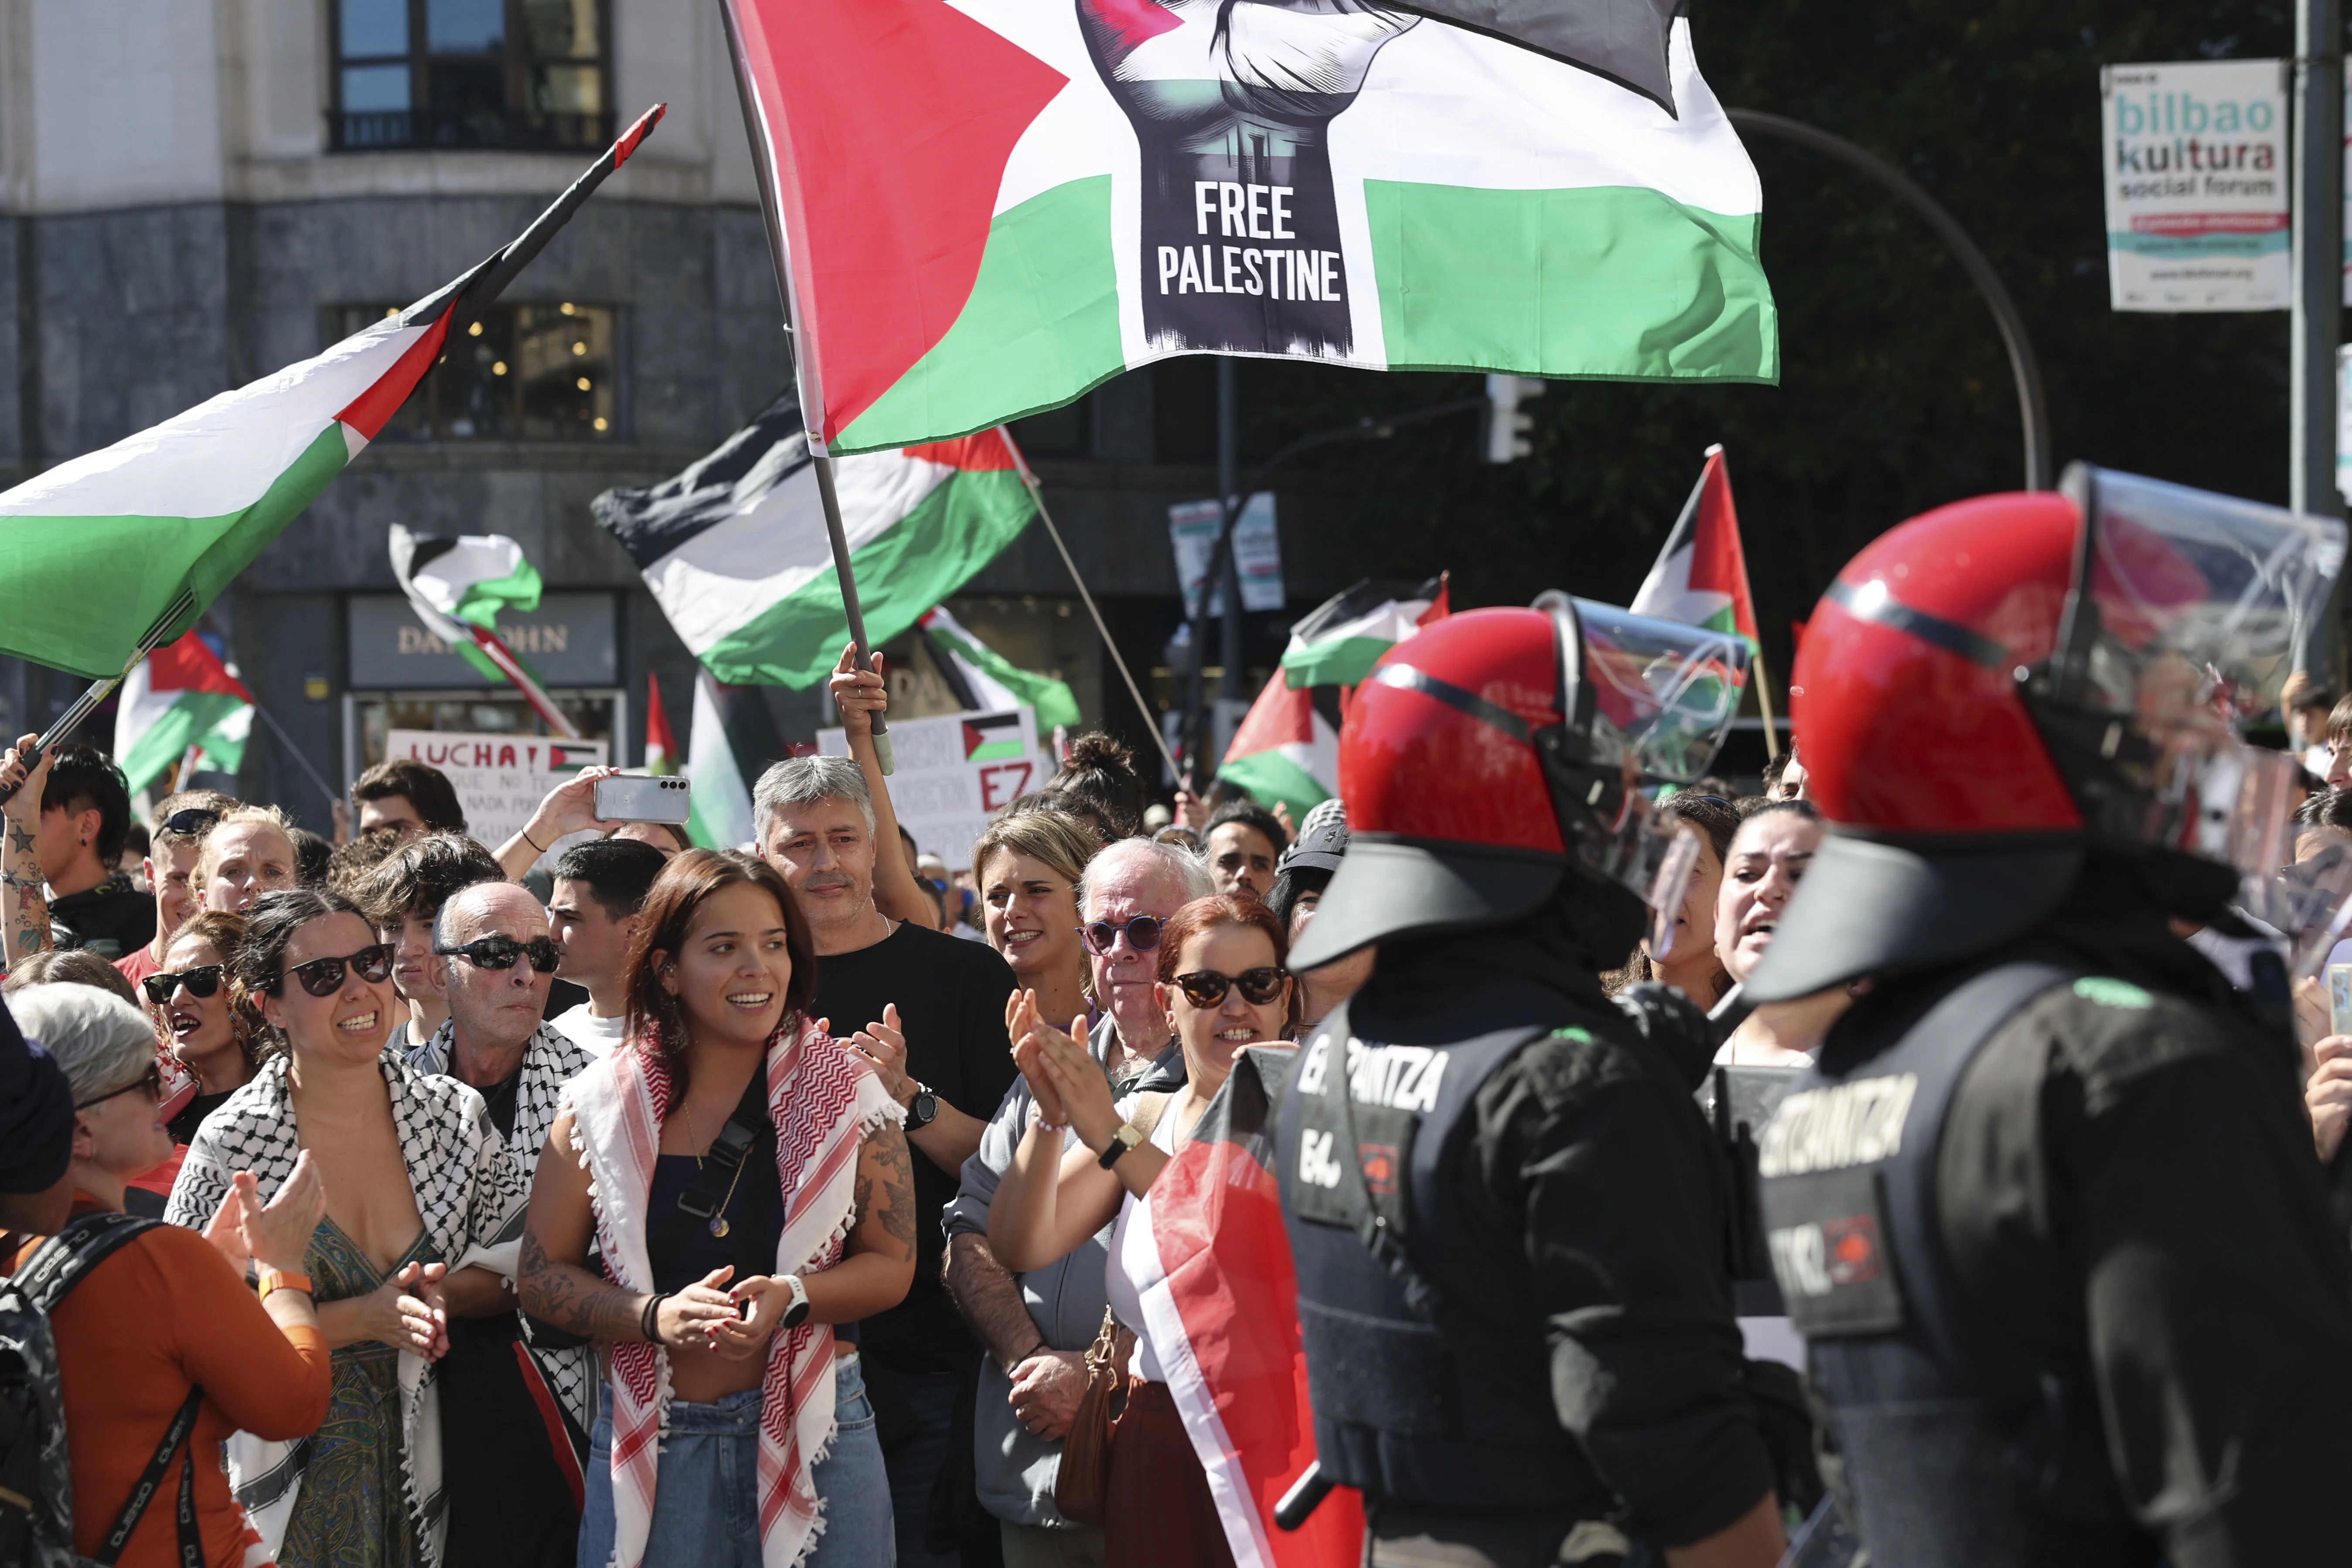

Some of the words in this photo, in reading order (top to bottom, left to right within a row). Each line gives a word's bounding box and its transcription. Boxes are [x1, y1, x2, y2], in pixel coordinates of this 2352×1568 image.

[2116, 91, 2274, 133] bilbao
[2117, 137, 2274, 173] kultura
[1195, 181, 1295, 239] FREE
[2119, 177, 2195, 200] social
[2205, 176, 2274, 196] forum
[1158, 245, 1340, 301] PALESTINE
[979, 761, 1033, 812] EZ
